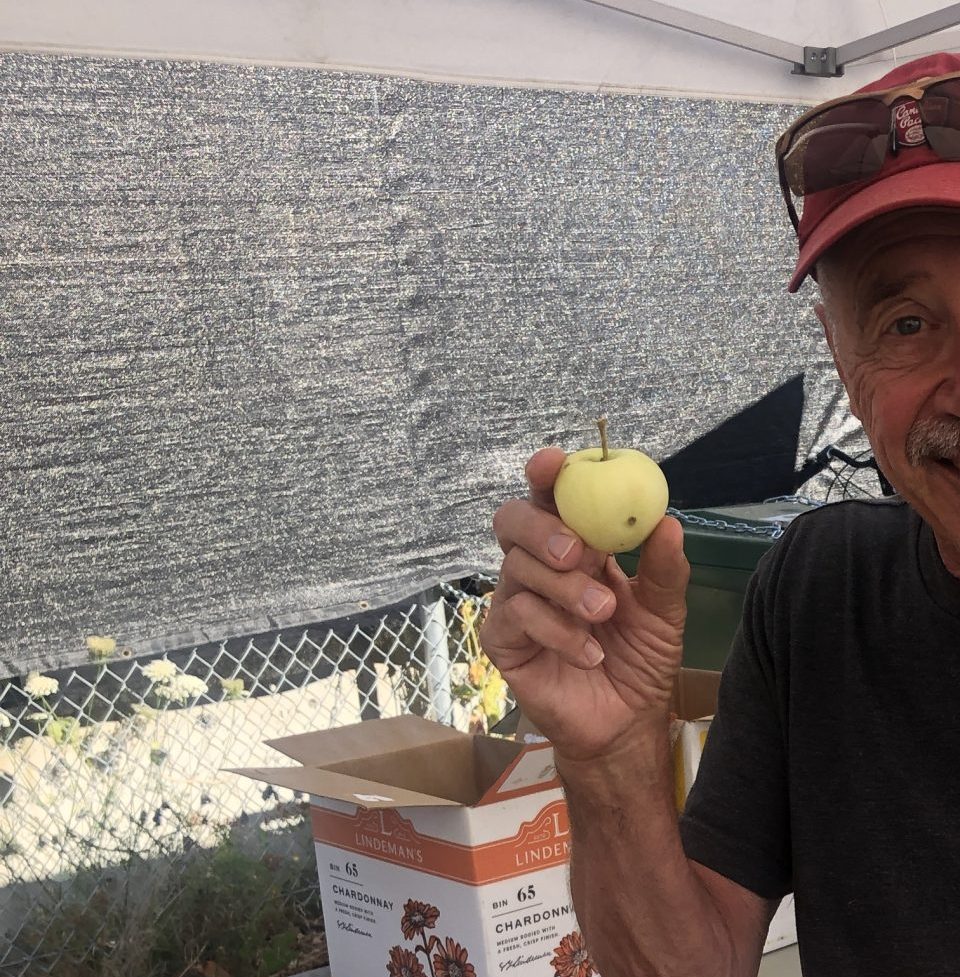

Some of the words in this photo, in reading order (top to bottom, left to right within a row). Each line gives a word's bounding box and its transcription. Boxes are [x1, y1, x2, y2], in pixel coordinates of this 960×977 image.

[355, 831, 424, 863] LINDEMAN'S
[345, 861, 359, 878] 65
[332, 884, 394, 911] CHARDONNAY
[491, 899, 509, 911] BIN
[516, 884, 537, 903] 65
[494, 904, 574, 935] CHARDONN
